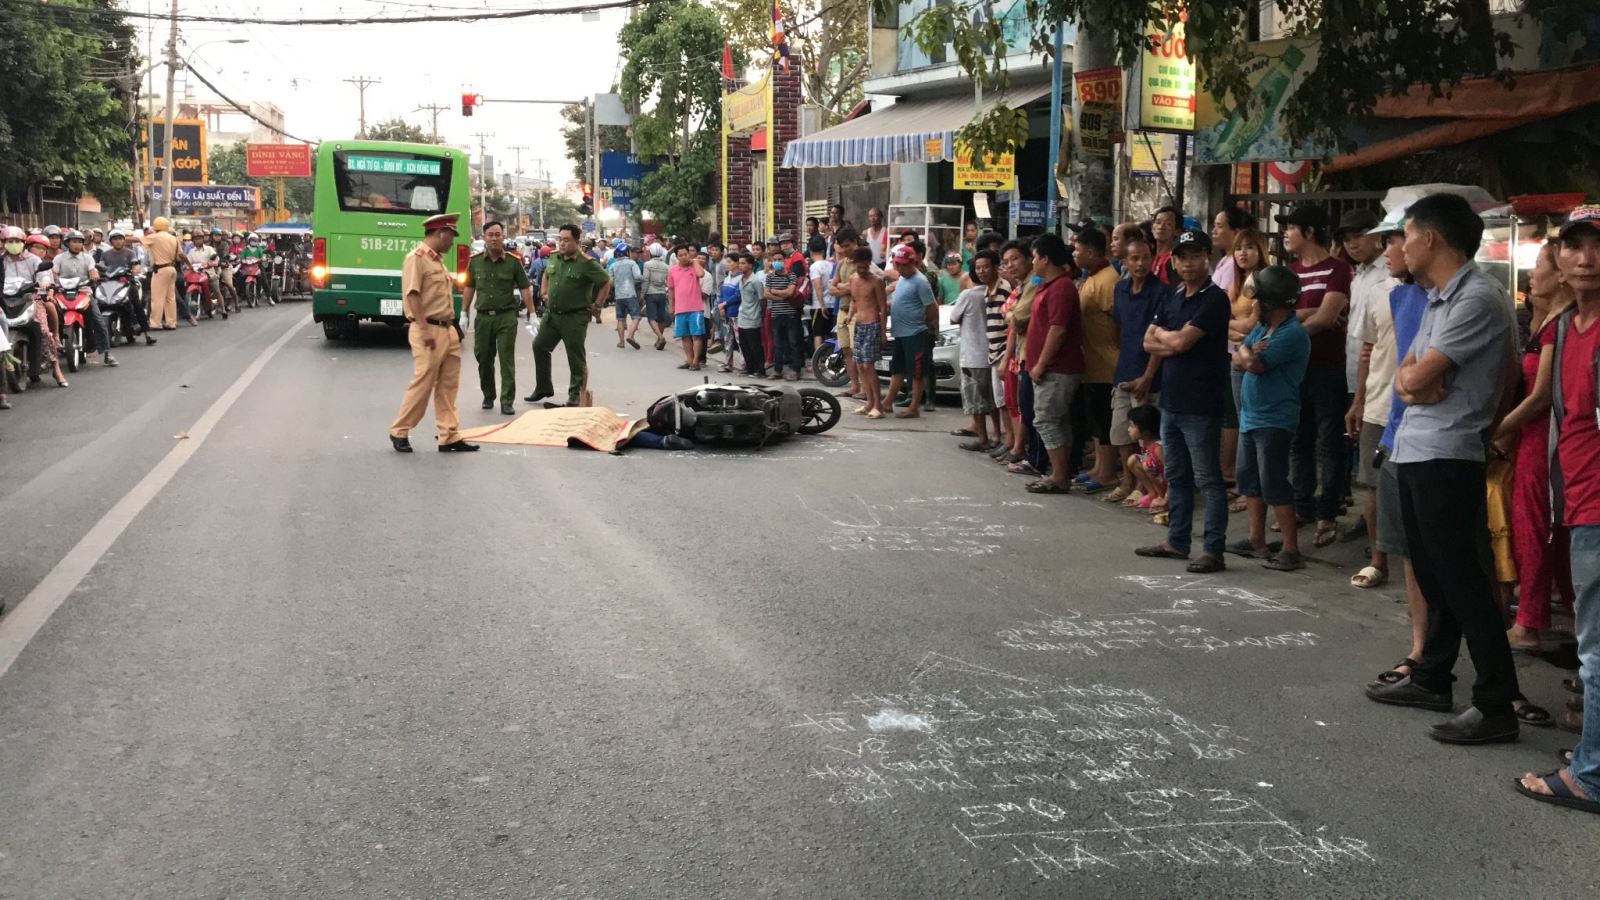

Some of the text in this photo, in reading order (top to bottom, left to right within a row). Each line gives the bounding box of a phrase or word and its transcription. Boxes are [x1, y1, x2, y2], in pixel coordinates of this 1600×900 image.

[171, 137, 188, 150] ÁN
[175, 156, 200, 169] GÓP
[175, 188, 191, 200] 0%
[1572, 208, 1600, 218] MOTU
